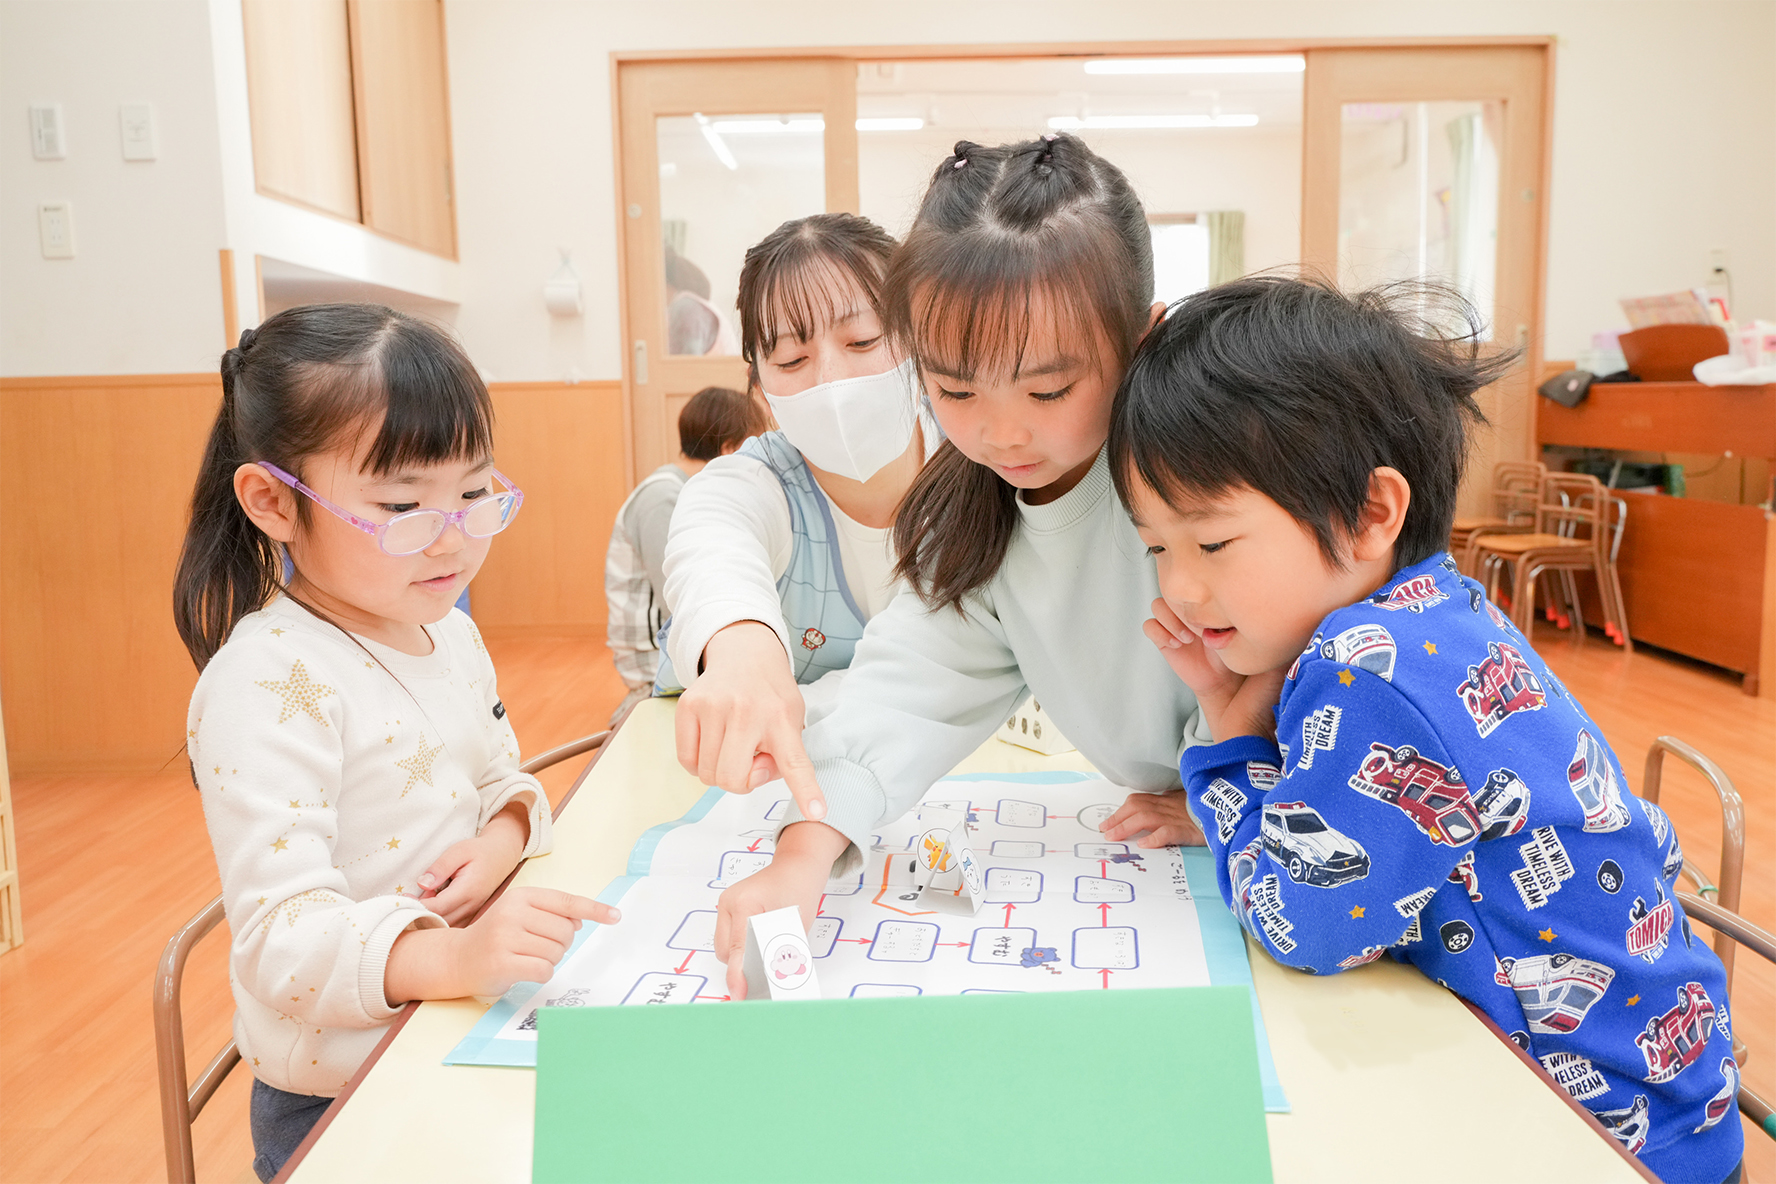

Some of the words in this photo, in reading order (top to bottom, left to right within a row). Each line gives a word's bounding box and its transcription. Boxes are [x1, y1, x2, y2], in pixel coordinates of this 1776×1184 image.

[1315, 709, 1336, 747] DREAM
[1222, 785, 1244, 806] WITH
[1524, 843, 1556, 890] TIMELESS
[1549, 849, 1571, 877] WITH
[1265, 876, 1281, 910] DREAM
[1516, 870, 1544, 904] DREAM
[1254, 887, 1289, 931] TIMELESS
[1267, 926, 1294, 951] DRIVE
[1629, 904, 1672, 951] TOMICA
[992, 935, 1013, 958] やすむ
[1549, 1053, 1578, 1069] WITH
[1568, 1074, 1604, 1097] DREAM
